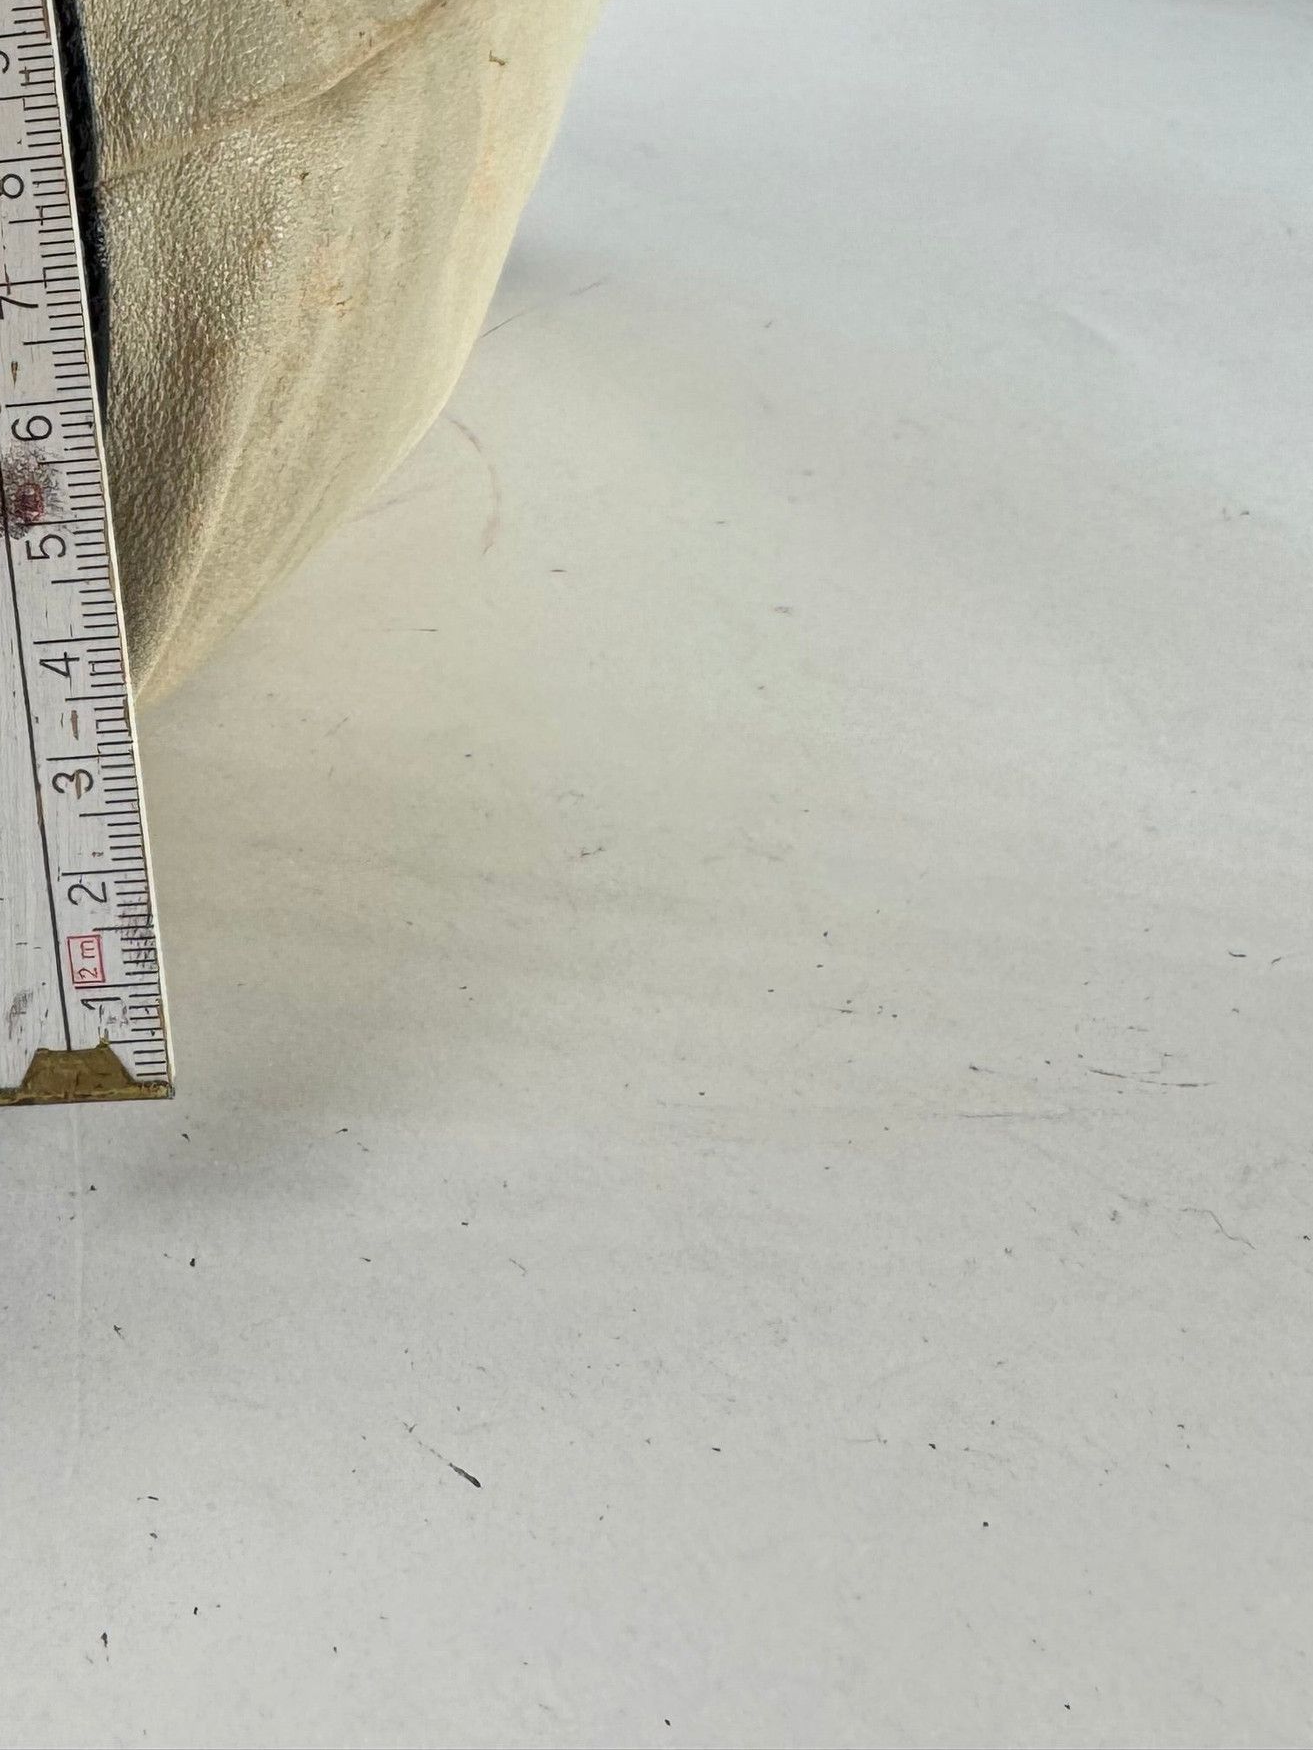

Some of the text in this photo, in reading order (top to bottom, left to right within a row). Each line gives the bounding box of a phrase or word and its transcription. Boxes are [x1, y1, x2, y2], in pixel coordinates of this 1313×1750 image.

[11, 415, 52, 441] 6
[26, 533, 66, 561] 5
[39, 651, 79, 678] 4
[52, 768, 94, 795] 3
[68, 881, 107, 906] 2
[80, 996, 122, 1010] 1
